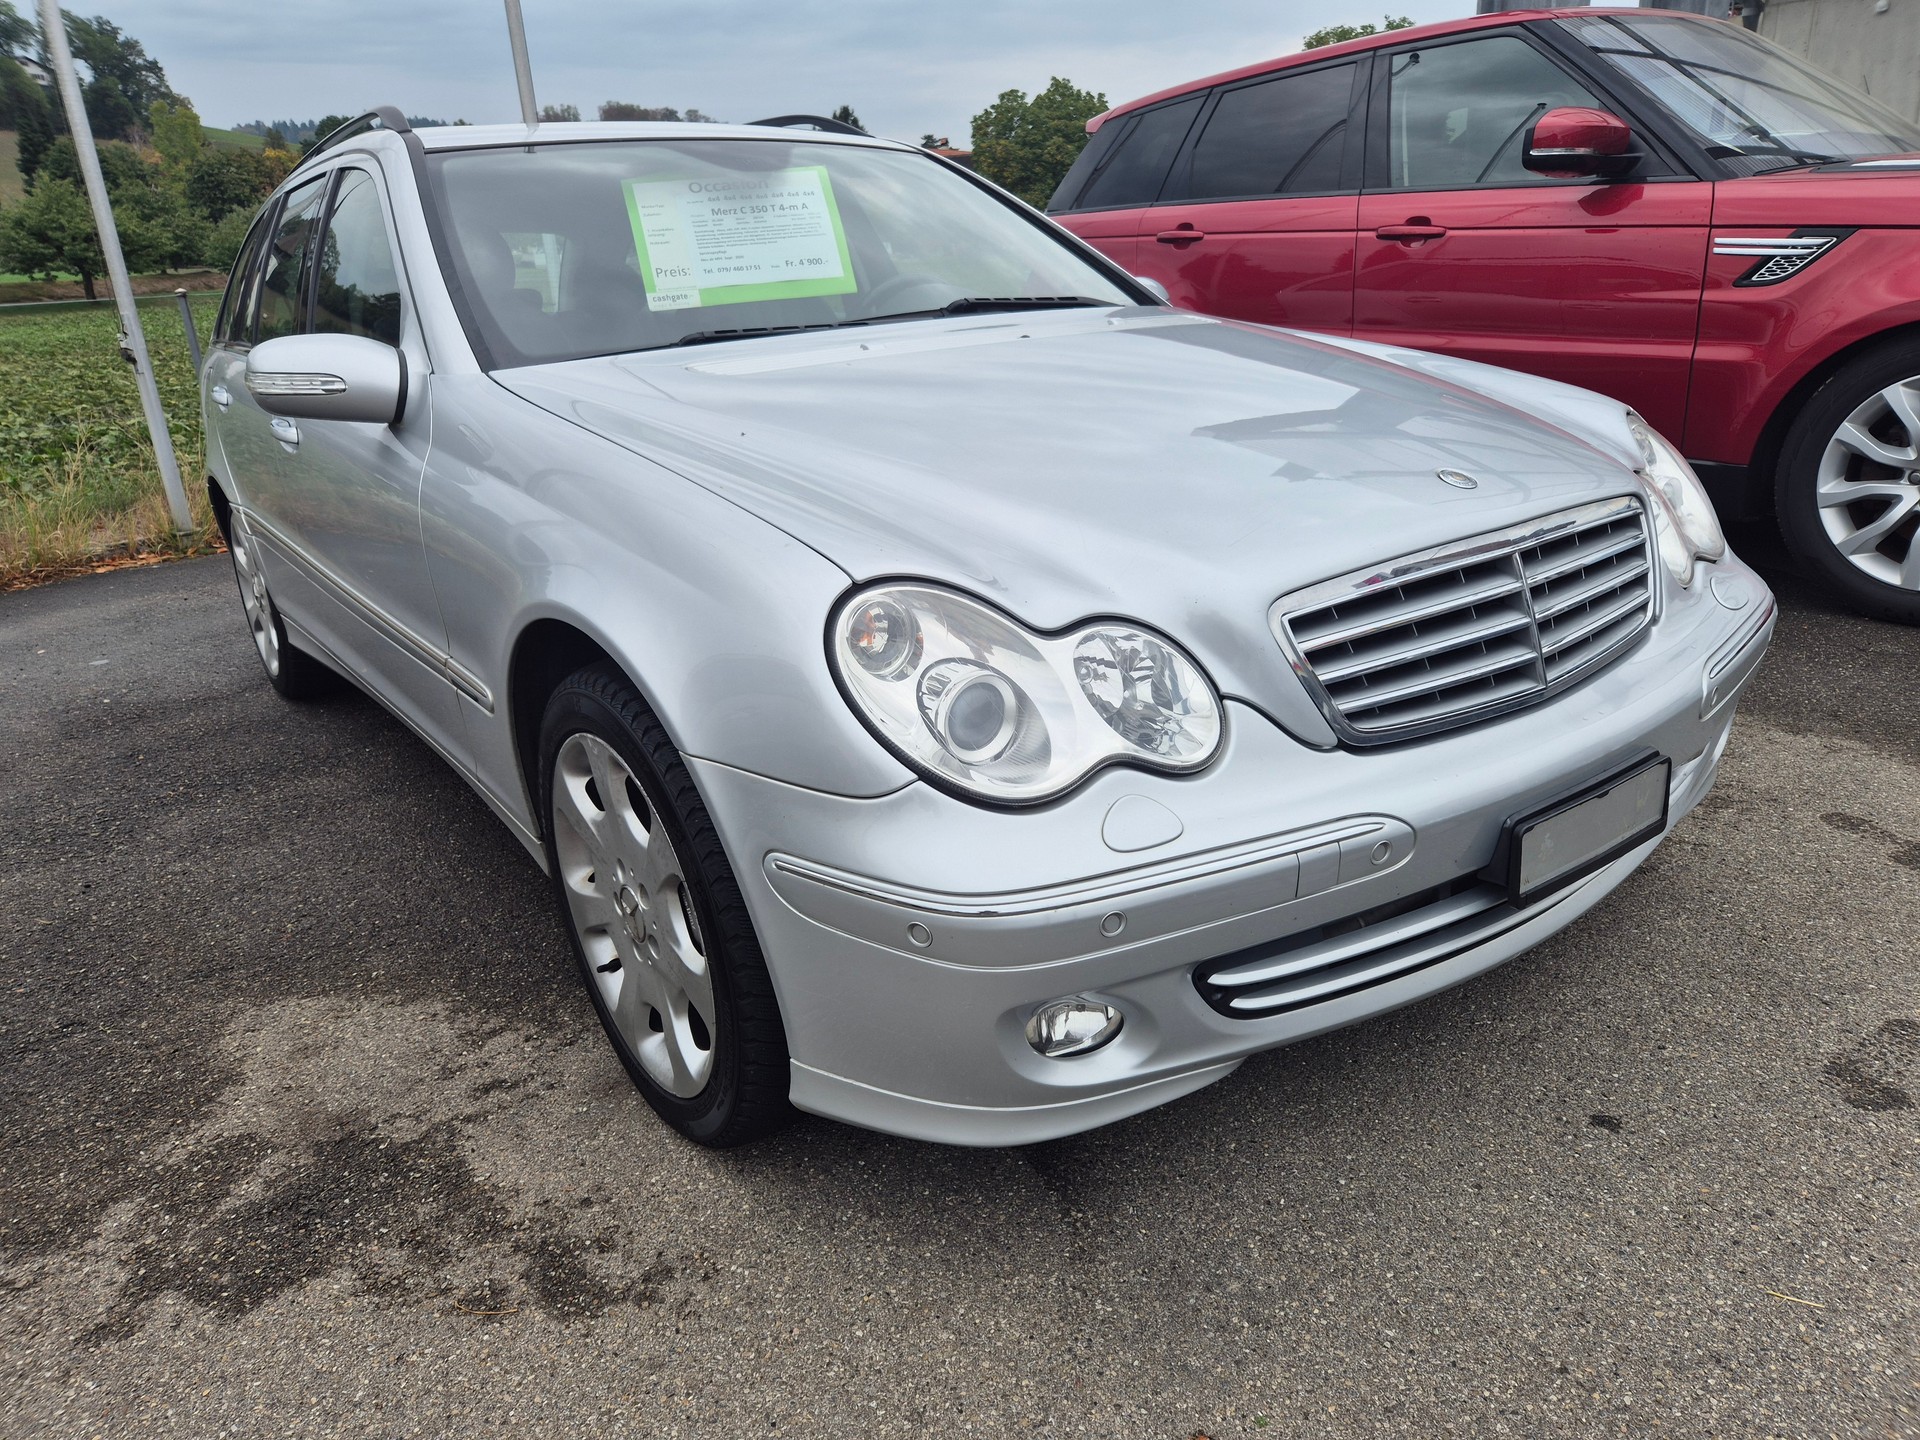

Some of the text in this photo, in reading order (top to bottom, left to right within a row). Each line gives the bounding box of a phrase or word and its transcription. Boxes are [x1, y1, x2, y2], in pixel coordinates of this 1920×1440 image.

[688, 180, 769, 193] Occasion
[711, 207, 738, 216] Merz
[740, 206, 747, 214] C
[750, 205, 768, 214] 350
[770, 204, 776, 212] T
[779, 203, 798, 211] 4-m
[655, 265, 691, 278] Preis:
[652, 293, 688, 303] cashgate
